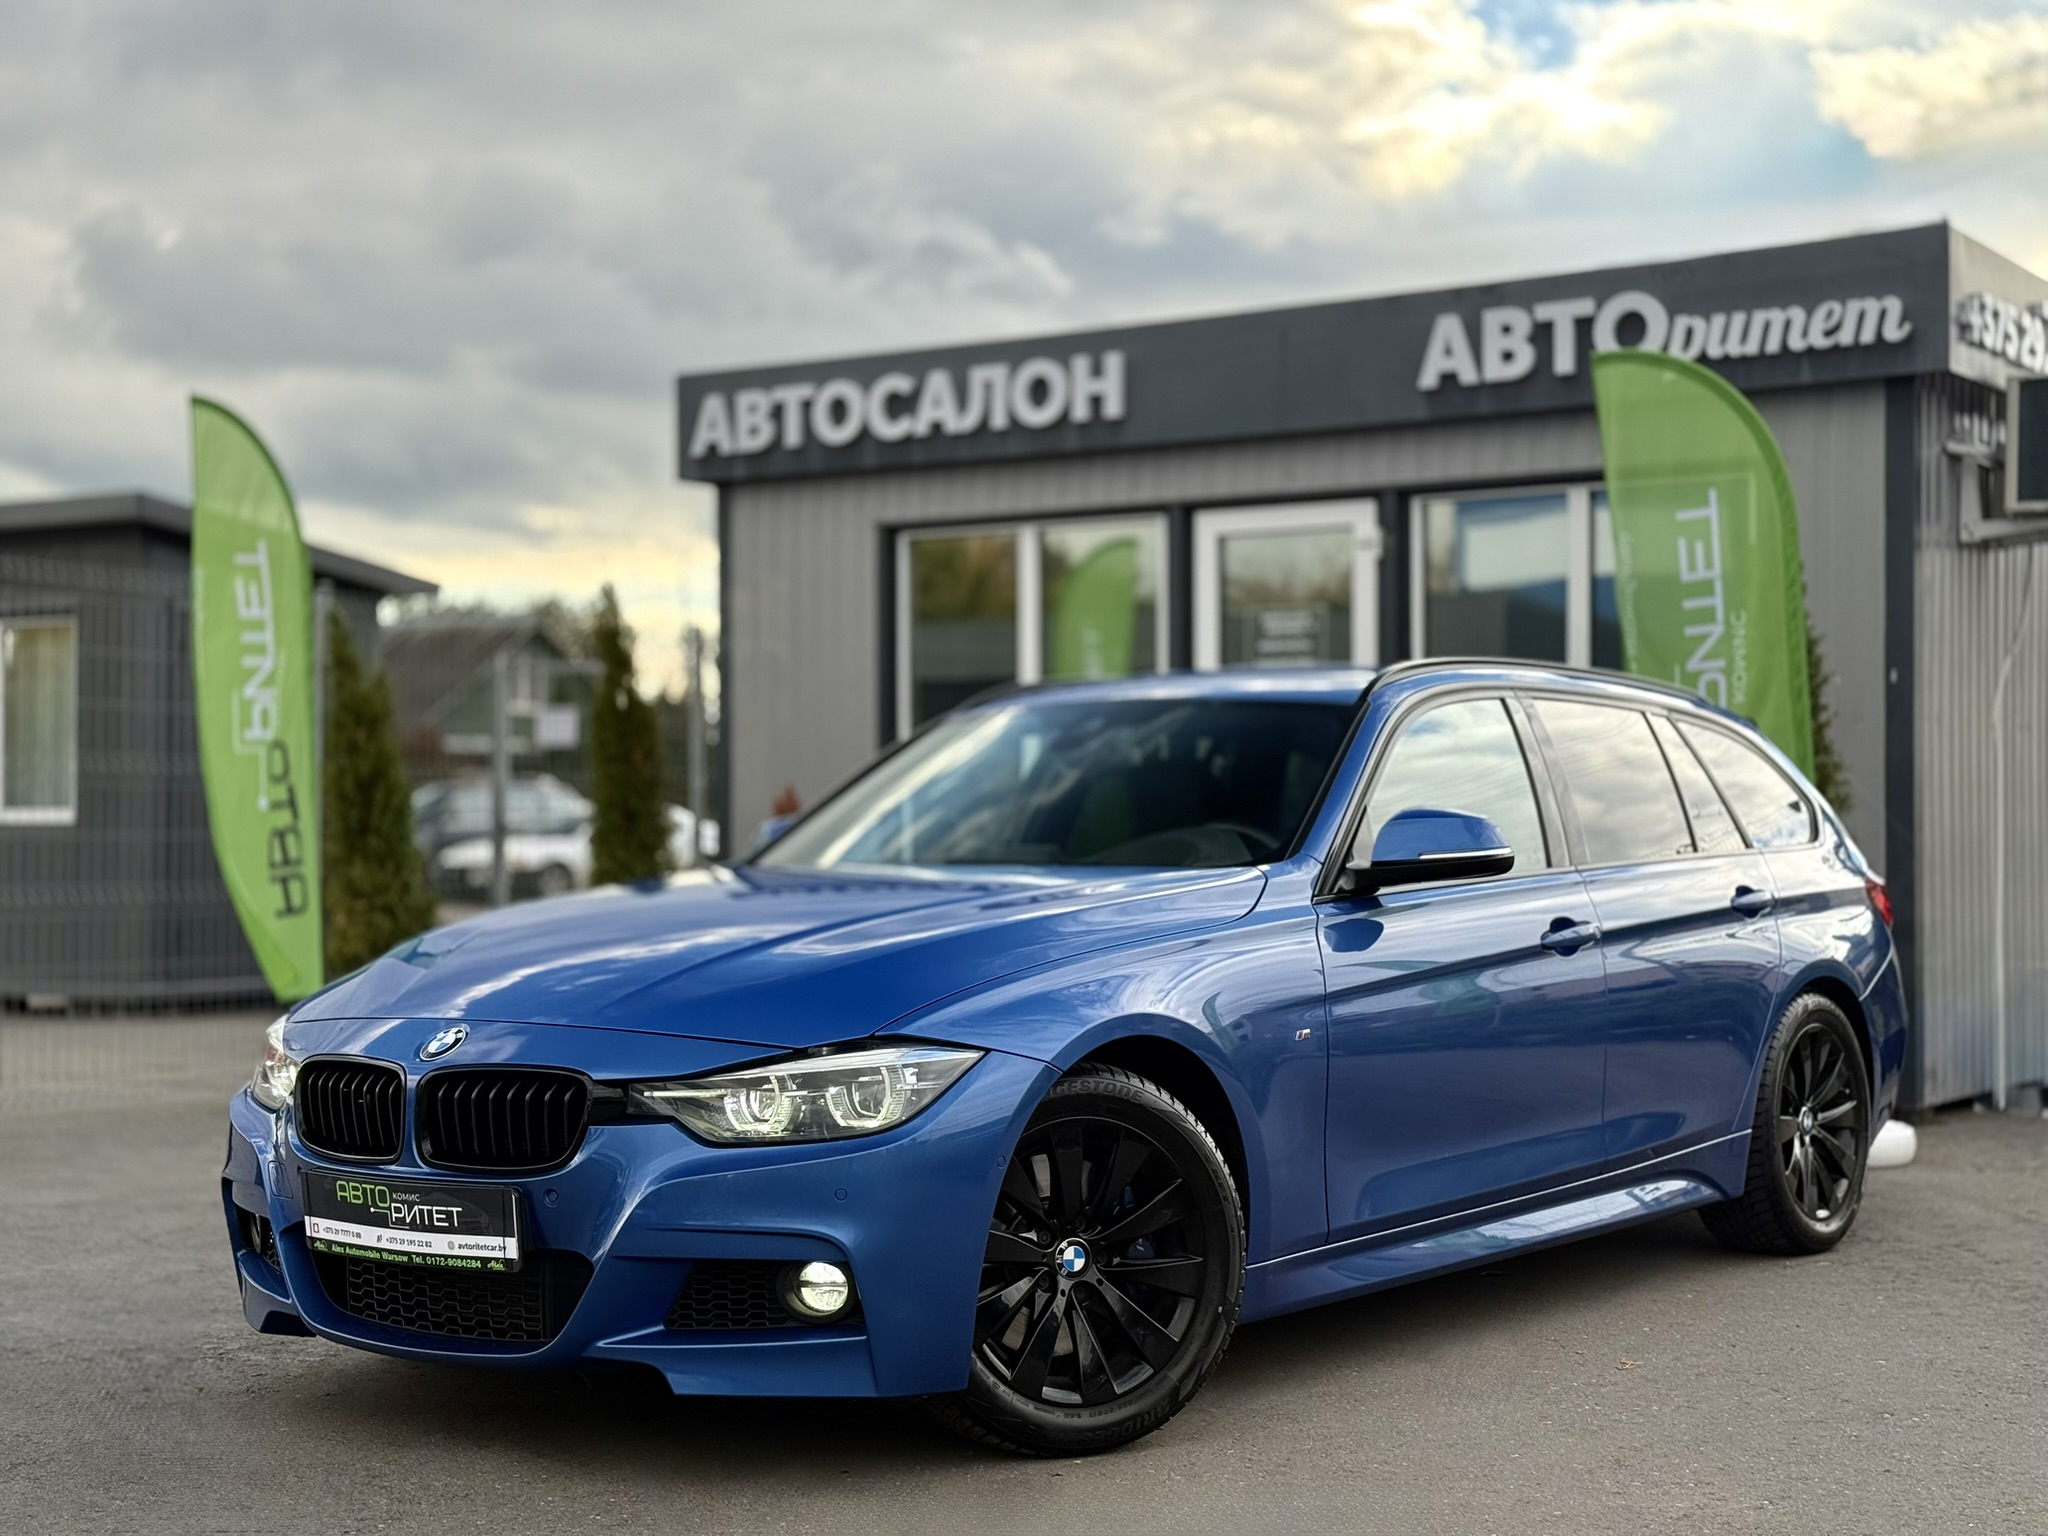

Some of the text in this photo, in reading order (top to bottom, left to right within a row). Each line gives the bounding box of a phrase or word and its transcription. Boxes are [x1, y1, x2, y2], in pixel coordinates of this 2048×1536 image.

[689, 350, 1127, 459] АВТОСАЛОН
[336, 1180, 390, 1207] АВТО
[392, 1192, 420, 1202] КОМИС
[391, 1202, 463, 1227] РИТЕТ
[345, 1245, 381, 1259] Automobile
[381, 1251, 409, 1262] Warsow
[411, 1254, 425, 1264] Tel.
